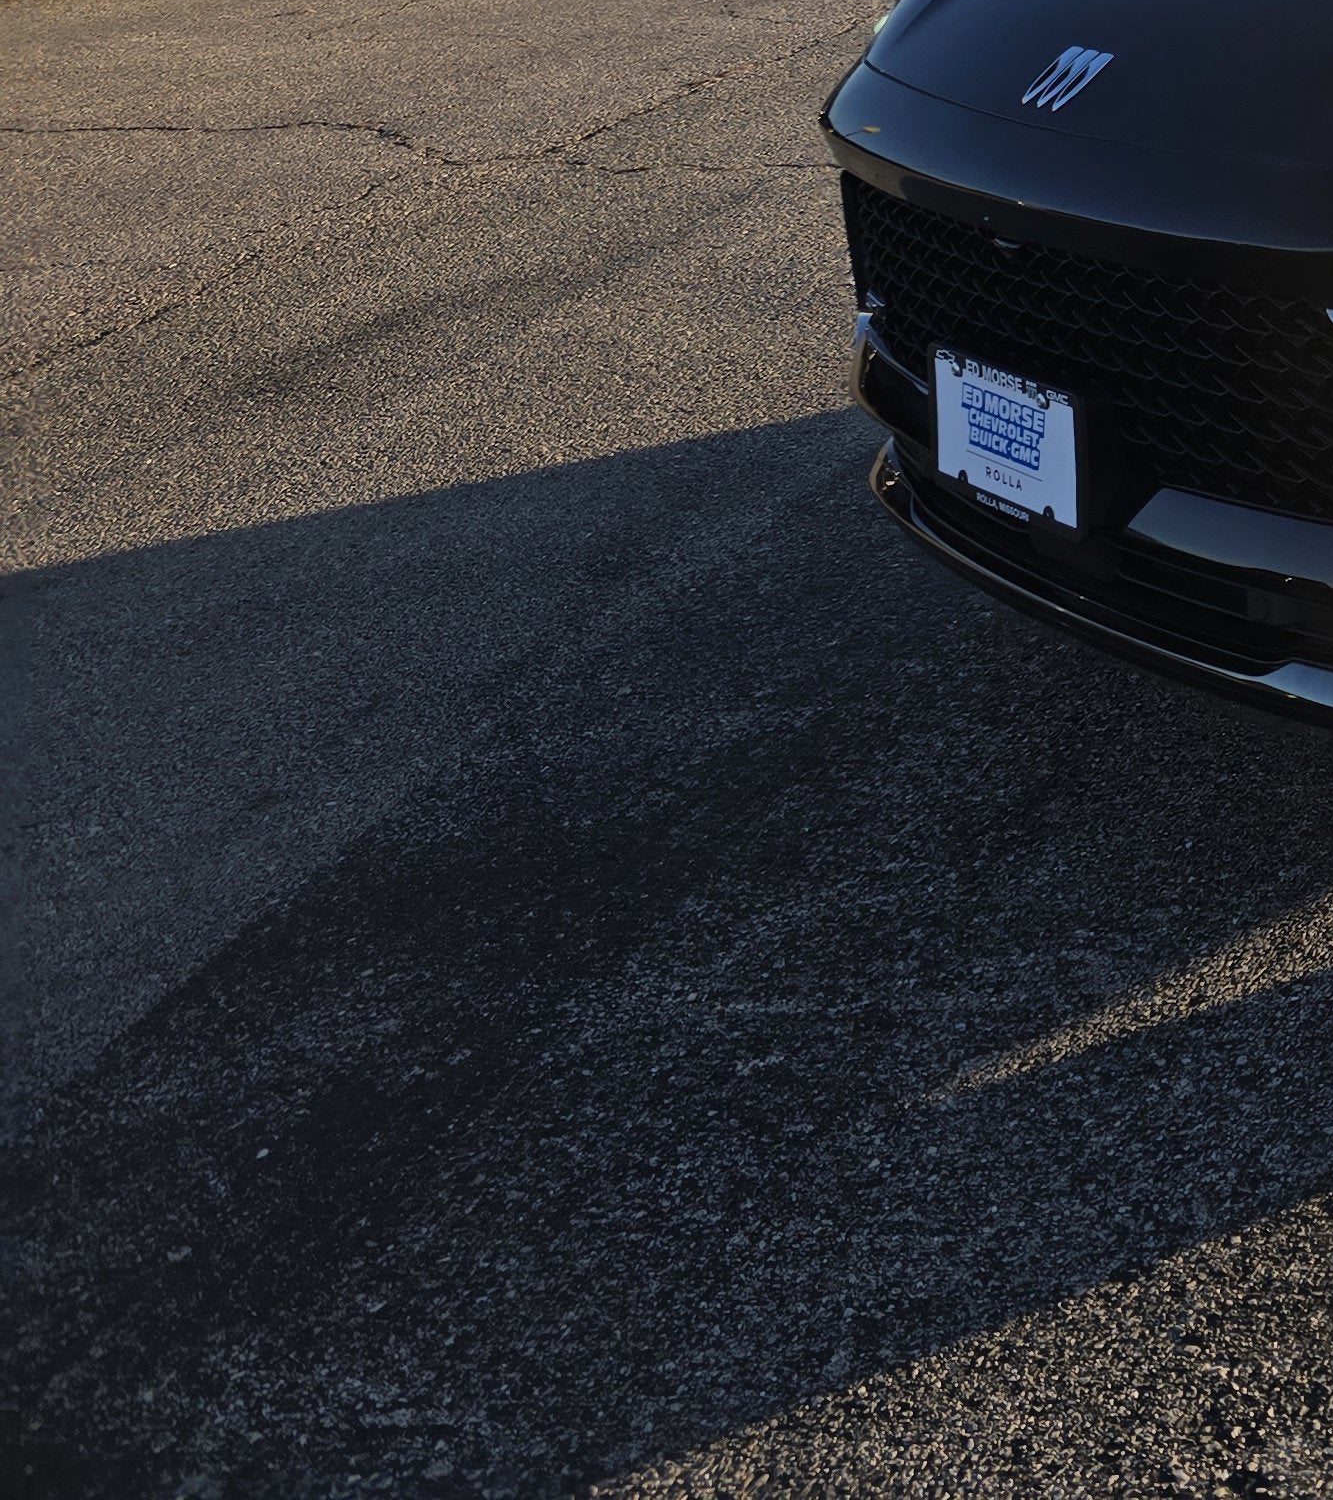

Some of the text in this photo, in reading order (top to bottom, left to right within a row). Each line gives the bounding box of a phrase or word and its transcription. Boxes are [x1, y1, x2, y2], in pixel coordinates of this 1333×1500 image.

[965, 358, 1024, 393] ED MORSE
[963, 384, 1045, 432] ED MORSE
[1046, 389, 1069, 406] GMC
[985, 466, 1023, 491] ROLLA
[998, 501, 1030, 522] MISSOURI
